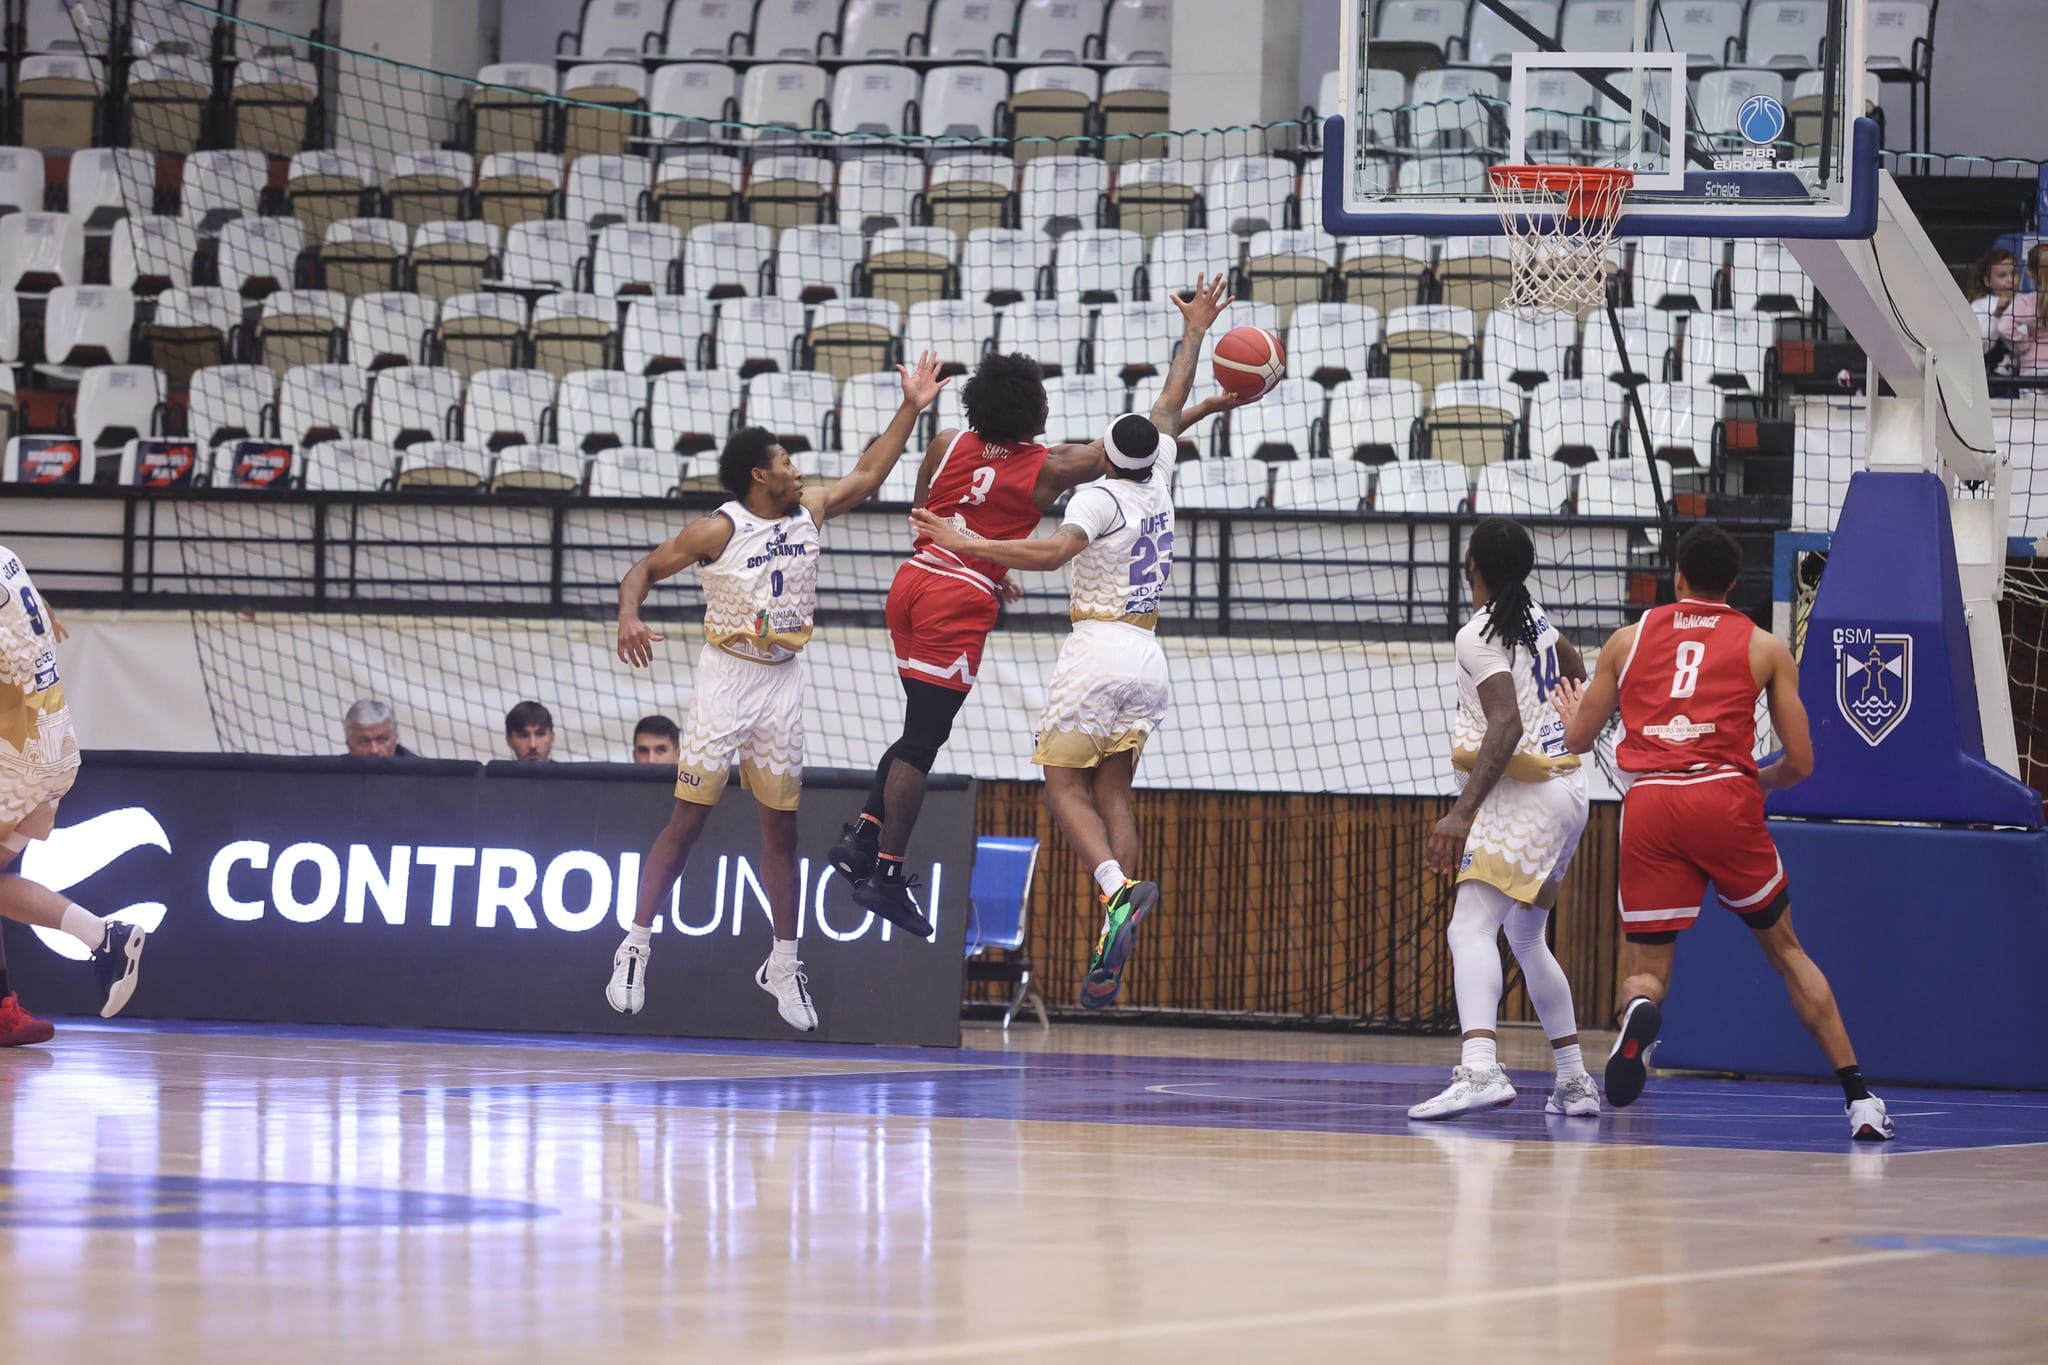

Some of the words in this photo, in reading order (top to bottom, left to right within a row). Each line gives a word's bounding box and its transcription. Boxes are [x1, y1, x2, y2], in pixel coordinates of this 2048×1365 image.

[1714, 160, 1773, 170] EUROPE
[1776, 160, 1805, 170] CUP
[1743, 148, 1776, 158] FIBA
[1704, 181, 1740, 198] Schelde
[959, 466, 996, 506] 3
[771, 569, 784, 597] 0
[20, 586, 45, 636] 9
[1833, 628, 1871, 644] CSM
[1531, 646, 1561, 704] 14
[1669, 640, 1706, 699] 8
